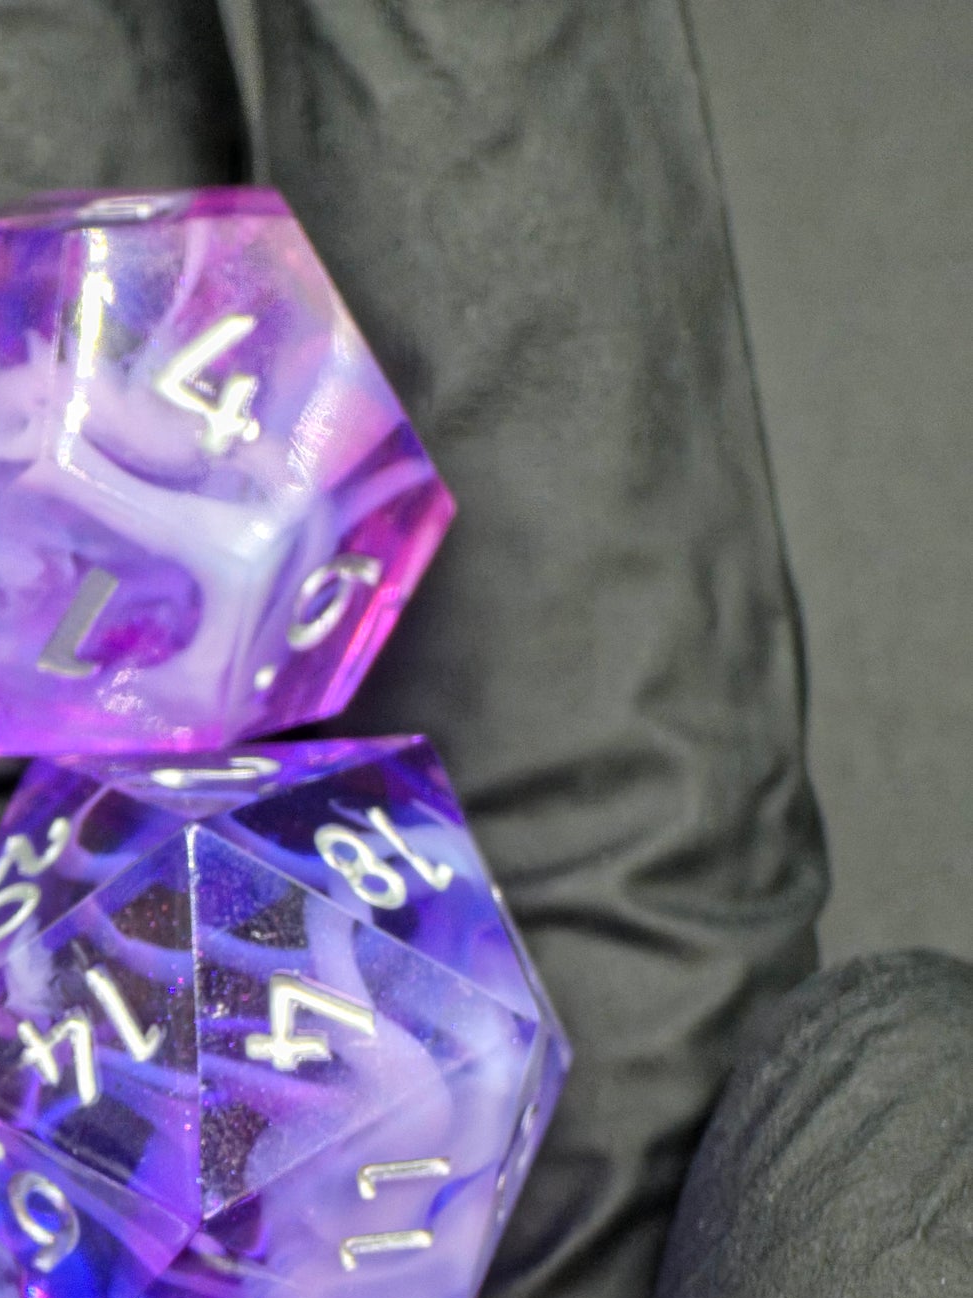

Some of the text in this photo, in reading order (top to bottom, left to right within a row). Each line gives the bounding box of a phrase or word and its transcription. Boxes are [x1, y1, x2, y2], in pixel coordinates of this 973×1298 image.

[153, 314, 261, 455] 4
[314, 807, 454, 910] 18
[19, 970, 164, 1105] 14
[246, 973, 375, 1071] 4
[340, 1159, 450, 1272] 11
